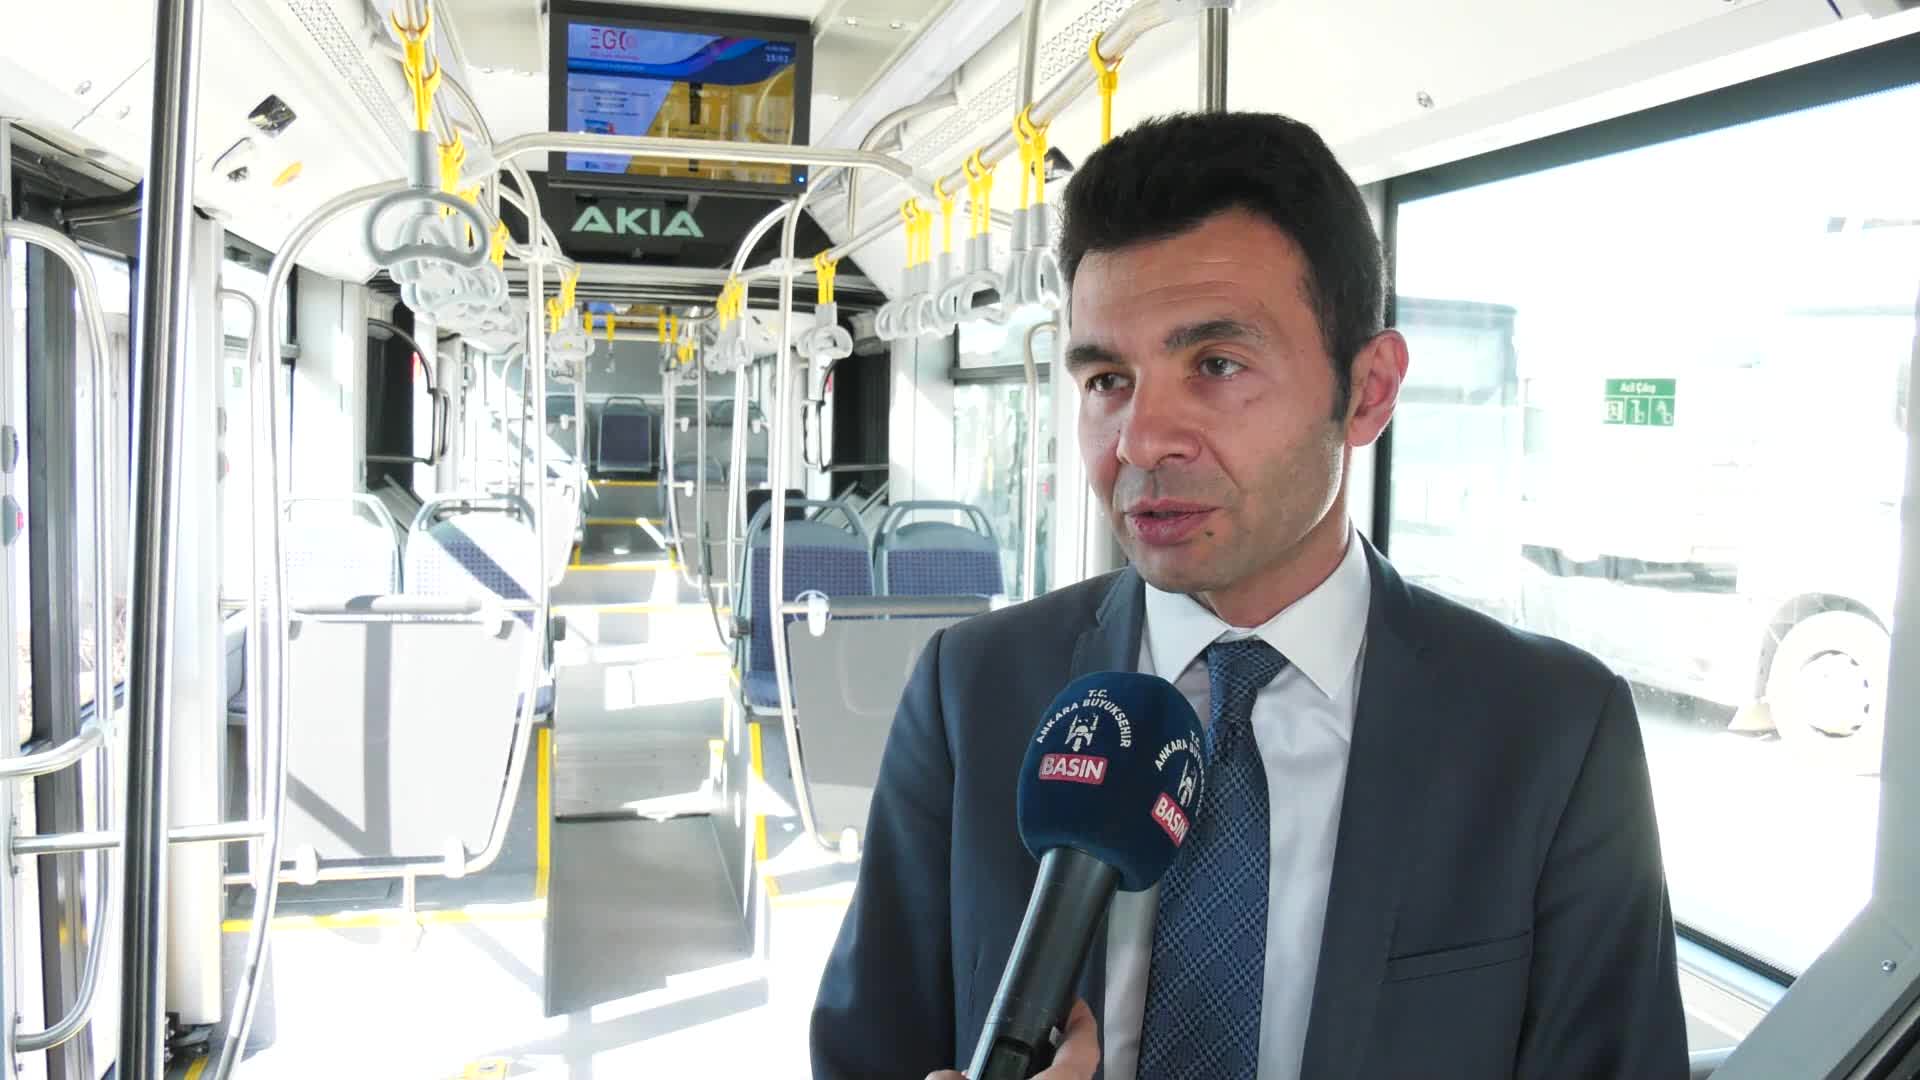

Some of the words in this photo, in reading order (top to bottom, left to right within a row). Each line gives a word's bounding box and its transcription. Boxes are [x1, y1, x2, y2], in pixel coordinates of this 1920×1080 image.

[571, 206, 704, 238] AKIA
[1087, 689, 1107, 698] T.C.
[1036, 702, 1079, 744] ANKARA
[1041, 757, 1104, 780] BASIN
[1154, 739, 1188, 772] ANKARA
[1156, 797, 1188, 843] BASIN
